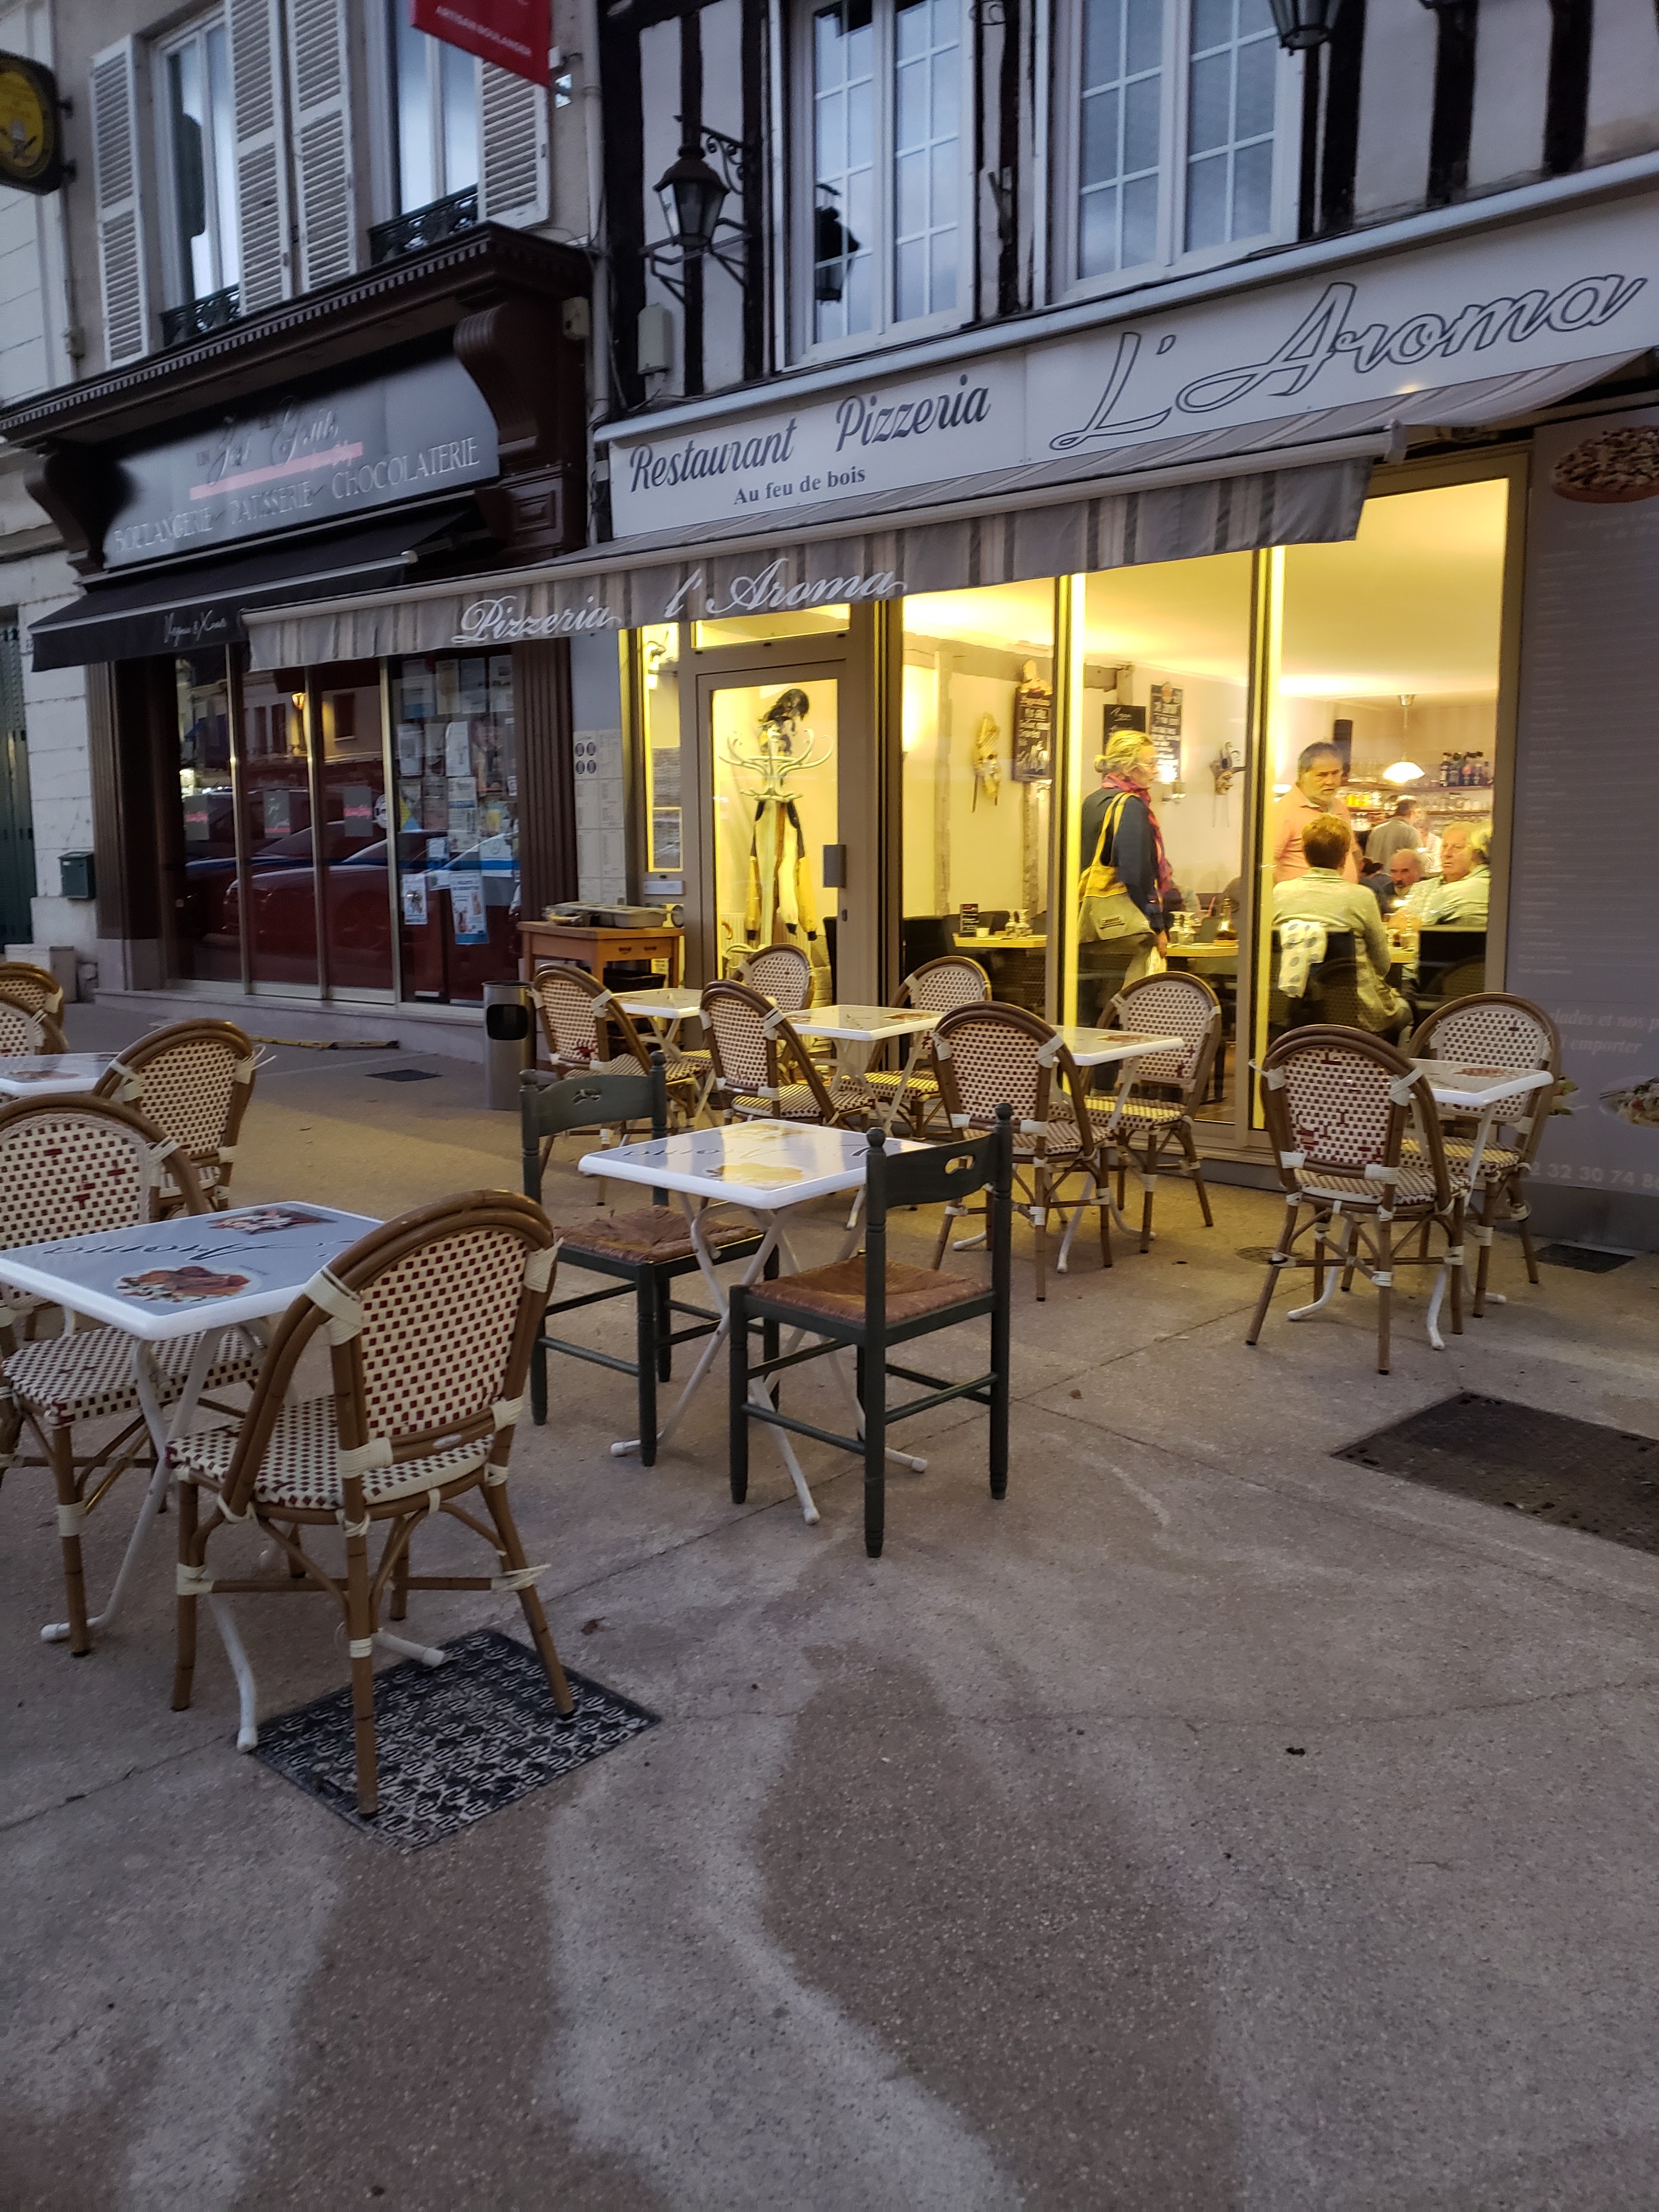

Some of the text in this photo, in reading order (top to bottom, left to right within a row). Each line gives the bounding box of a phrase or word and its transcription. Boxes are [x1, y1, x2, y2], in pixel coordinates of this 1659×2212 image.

[629, 374, 990, 493] Restaurant Pizzeria
[331, 437, 480, 499] CHOCOLATERIE
[733, 464, 866, 506] Au feu de bois
[450, 594, 622, 644] Pizzeria
[1547, 1163, 1572, 1179] 32
[1579, 1166, 1605, 1182] 30
